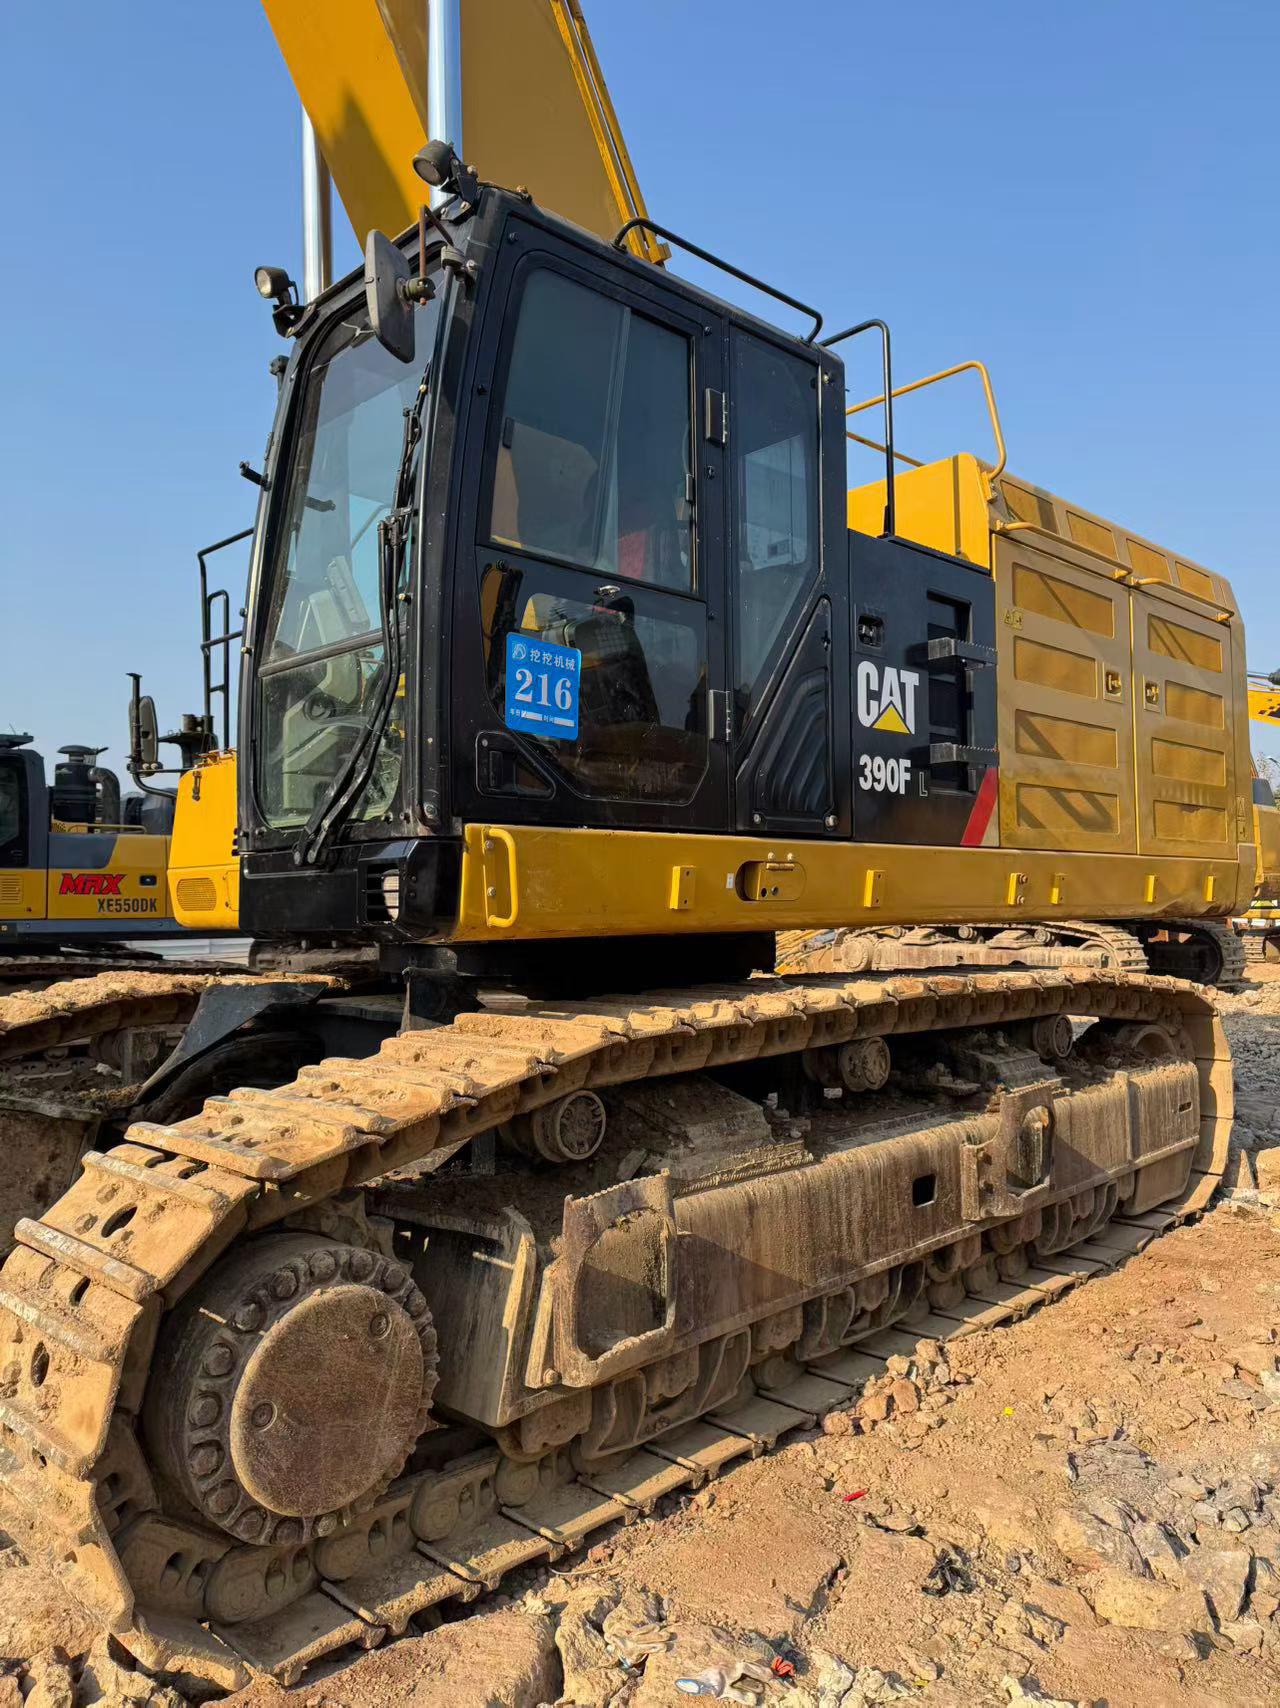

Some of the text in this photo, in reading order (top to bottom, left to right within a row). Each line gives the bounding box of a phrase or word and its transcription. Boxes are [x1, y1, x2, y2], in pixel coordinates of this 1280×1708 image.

[529, 648, 575, 671] 挖挖机械
[515, 669, 572, 710] 216
[857, 661, 919, 734] CAT
[858, 754, 911, 795] 390F
[97, 898, 157, 913] XE550DK
